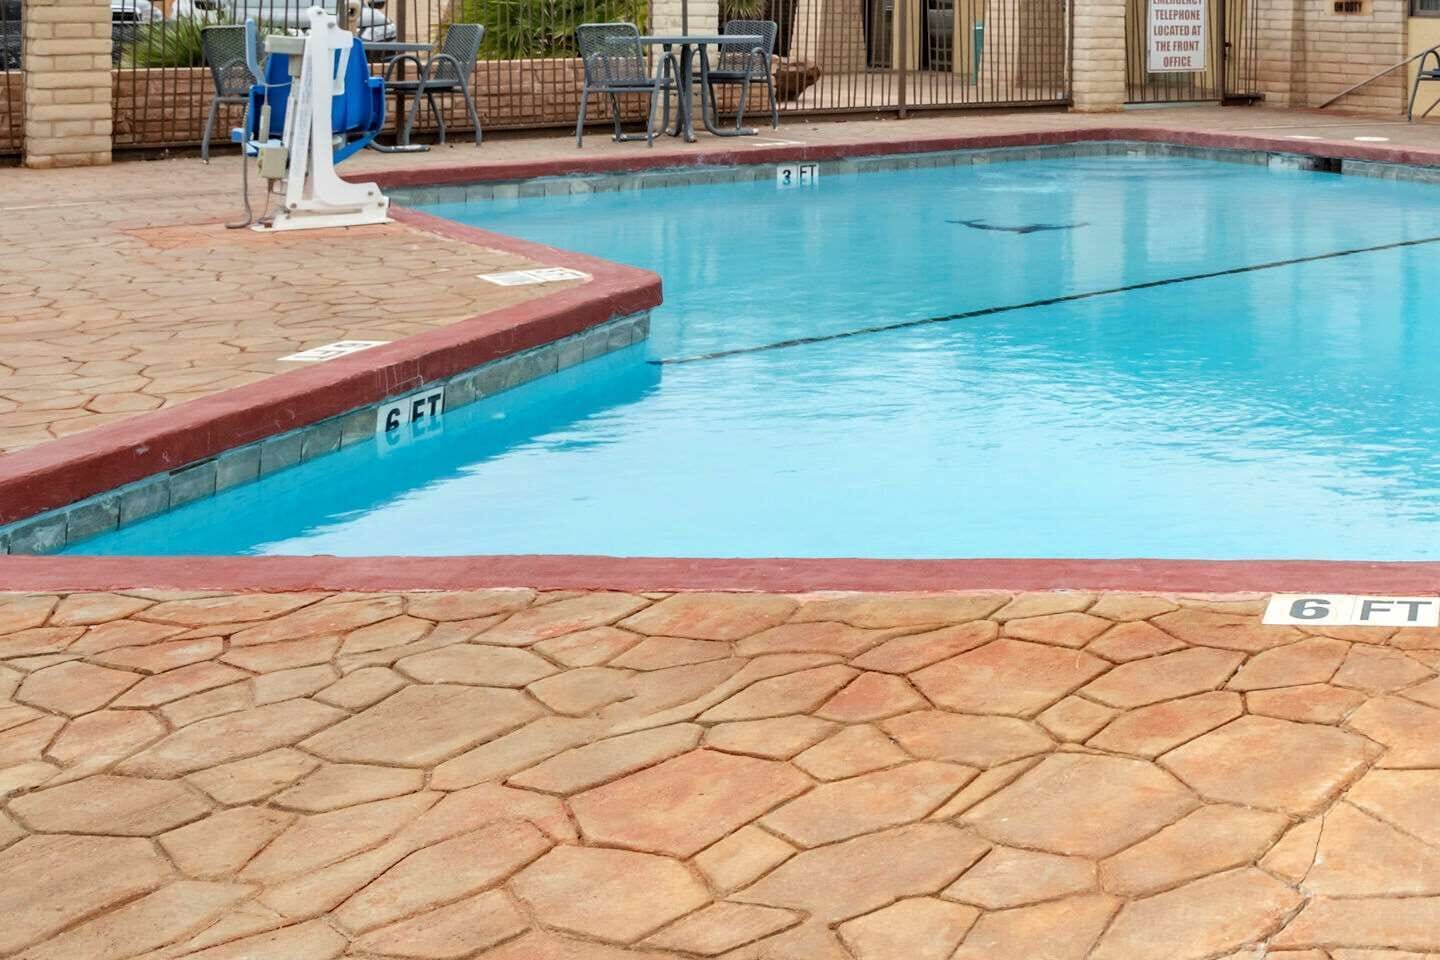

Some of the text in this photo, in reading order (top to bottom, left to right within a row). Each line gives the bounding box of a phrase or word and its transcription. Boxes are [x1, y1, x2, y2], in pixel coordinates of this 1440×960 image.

[1334, 1, 1362, 12] ON DUTY
[1155, 9, 1201, 21] TELEPHONE
[1154, 25, 1202, 37] LOCATED AT
[1155, 40, 1200, 52] THE FRONT
[1163, 56, 1192, 68] OFFICE
[385, 394, 441, 433] 6 FT
[1289, 598, 1433, 622] 6 FT
